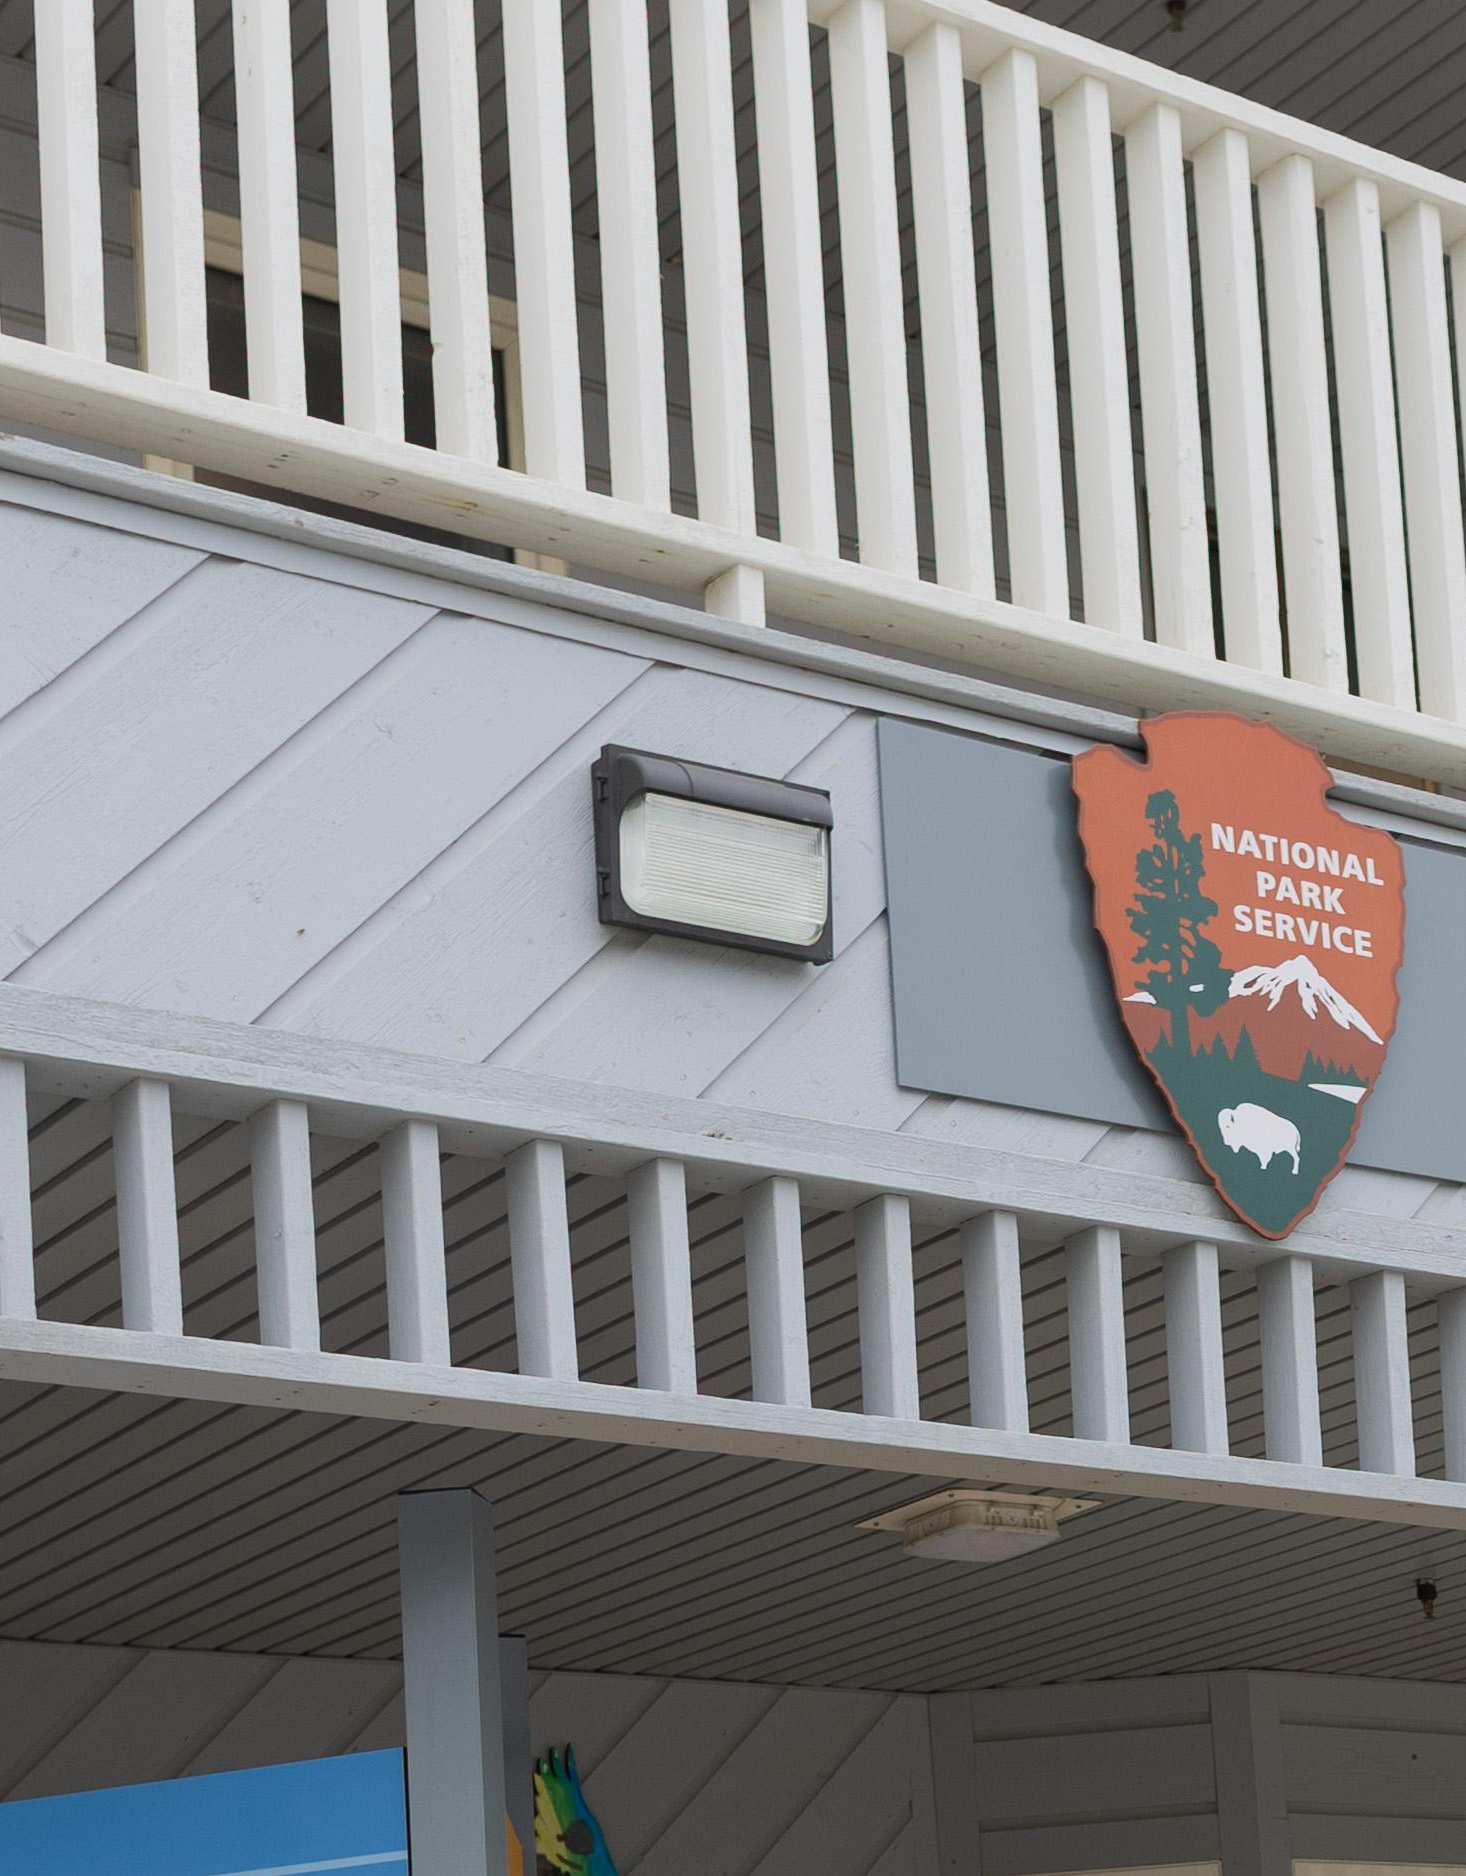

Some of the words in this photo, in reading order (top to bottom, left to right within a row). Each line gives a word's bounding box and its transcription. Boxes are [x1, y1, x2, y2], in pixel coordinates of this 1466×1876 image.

[1211, 823, 1384, 886] NATIONAL
[1256, 871, 1345, 915] PARK
[1233, 905, 1374, 958] SERVICE
